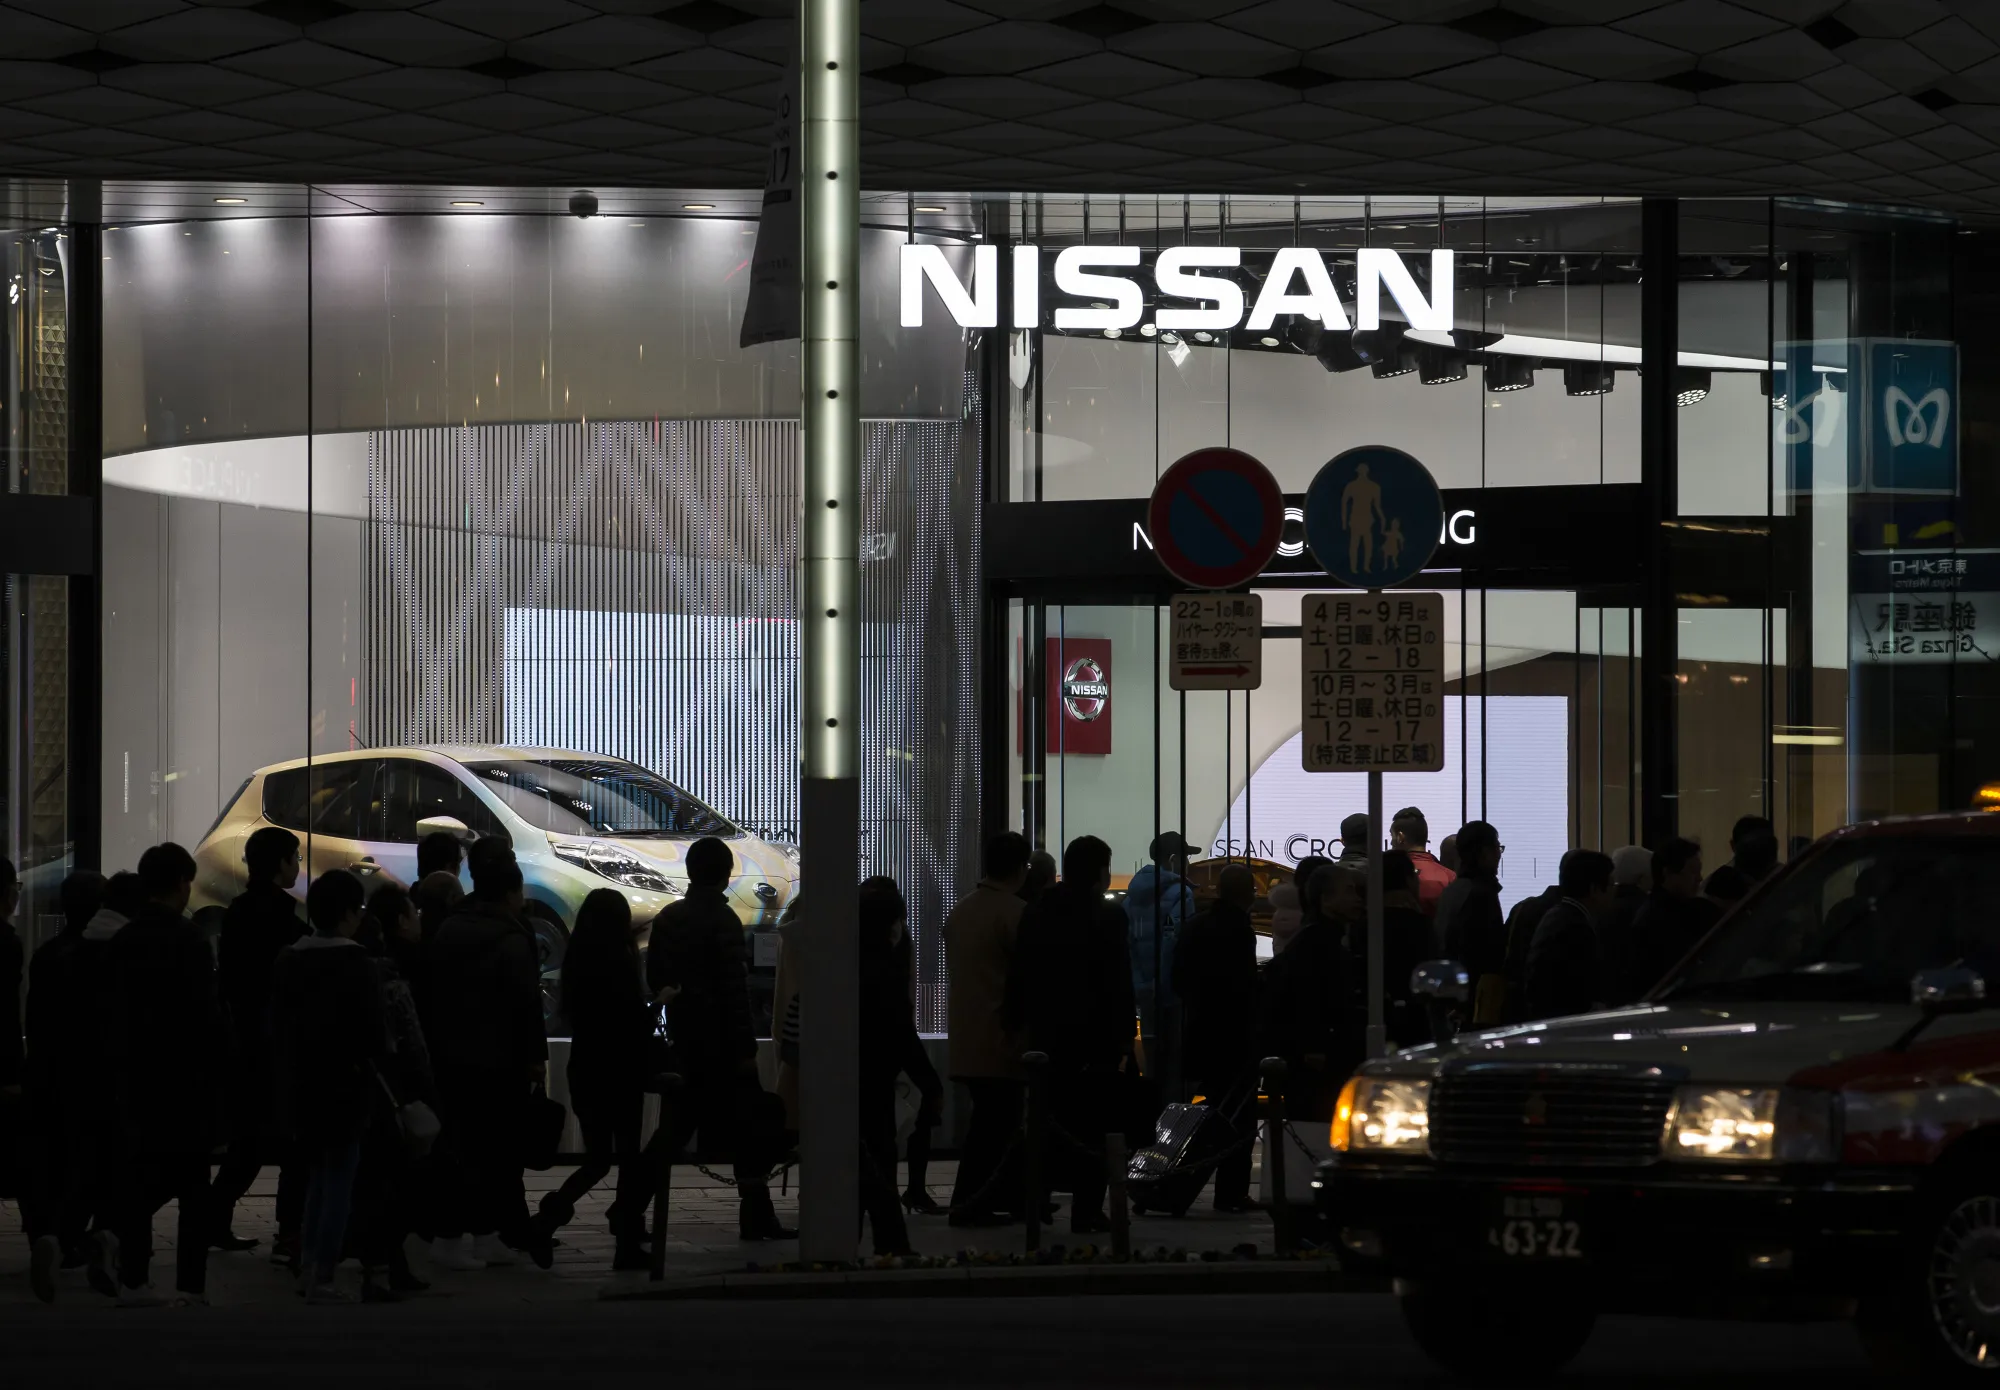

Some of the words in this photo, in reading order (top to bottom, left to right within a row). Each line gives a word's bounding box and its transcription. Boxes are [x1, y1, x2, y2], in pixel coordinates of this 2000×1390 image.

[900, 244, 1454, 331] NISSAN
[1071, 685, 1108, 695] NISSAN
[1208, 839, 1274, 858] ISSAN
[1502, 1219, 1583, 1258] 63-22
